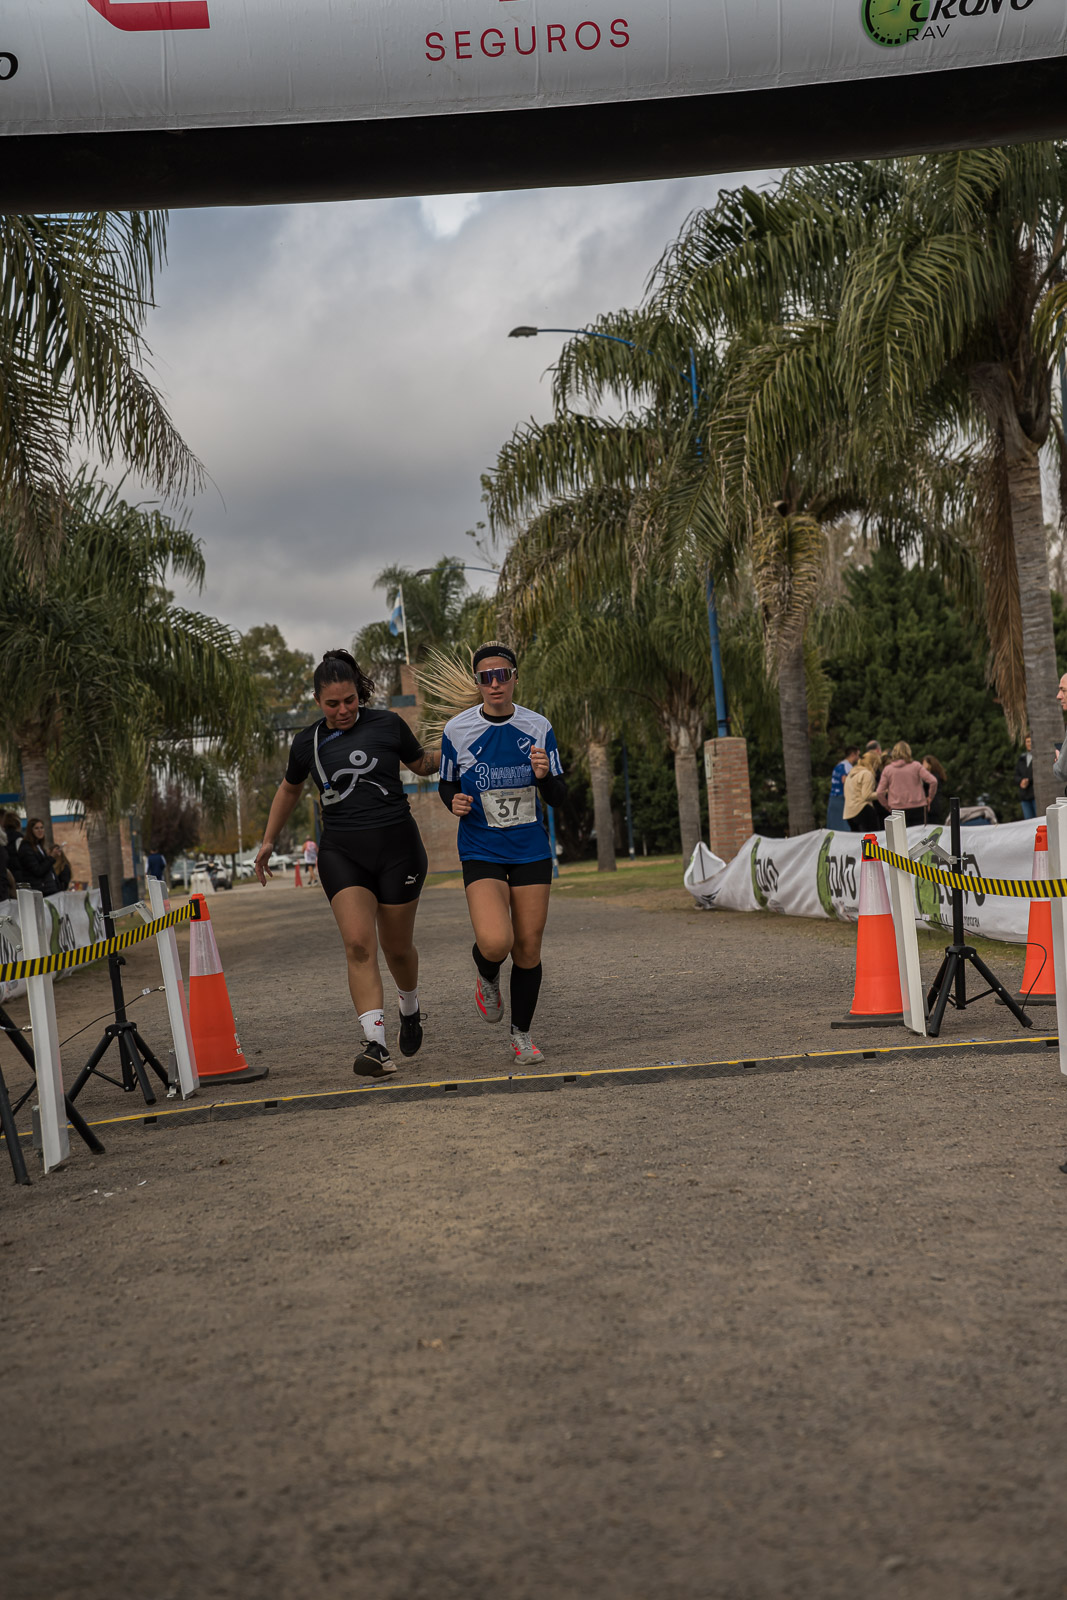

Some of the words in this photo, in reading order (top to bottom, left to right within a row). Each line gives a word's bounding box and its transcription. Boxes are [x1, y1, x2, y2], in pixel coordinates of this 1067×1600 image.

[425, 18, 630, 62] SEGUROS
[906, 24, 950, 42] RAV
[475, 762, 490, 791] 3
[495, 797, 522, 818] 37
